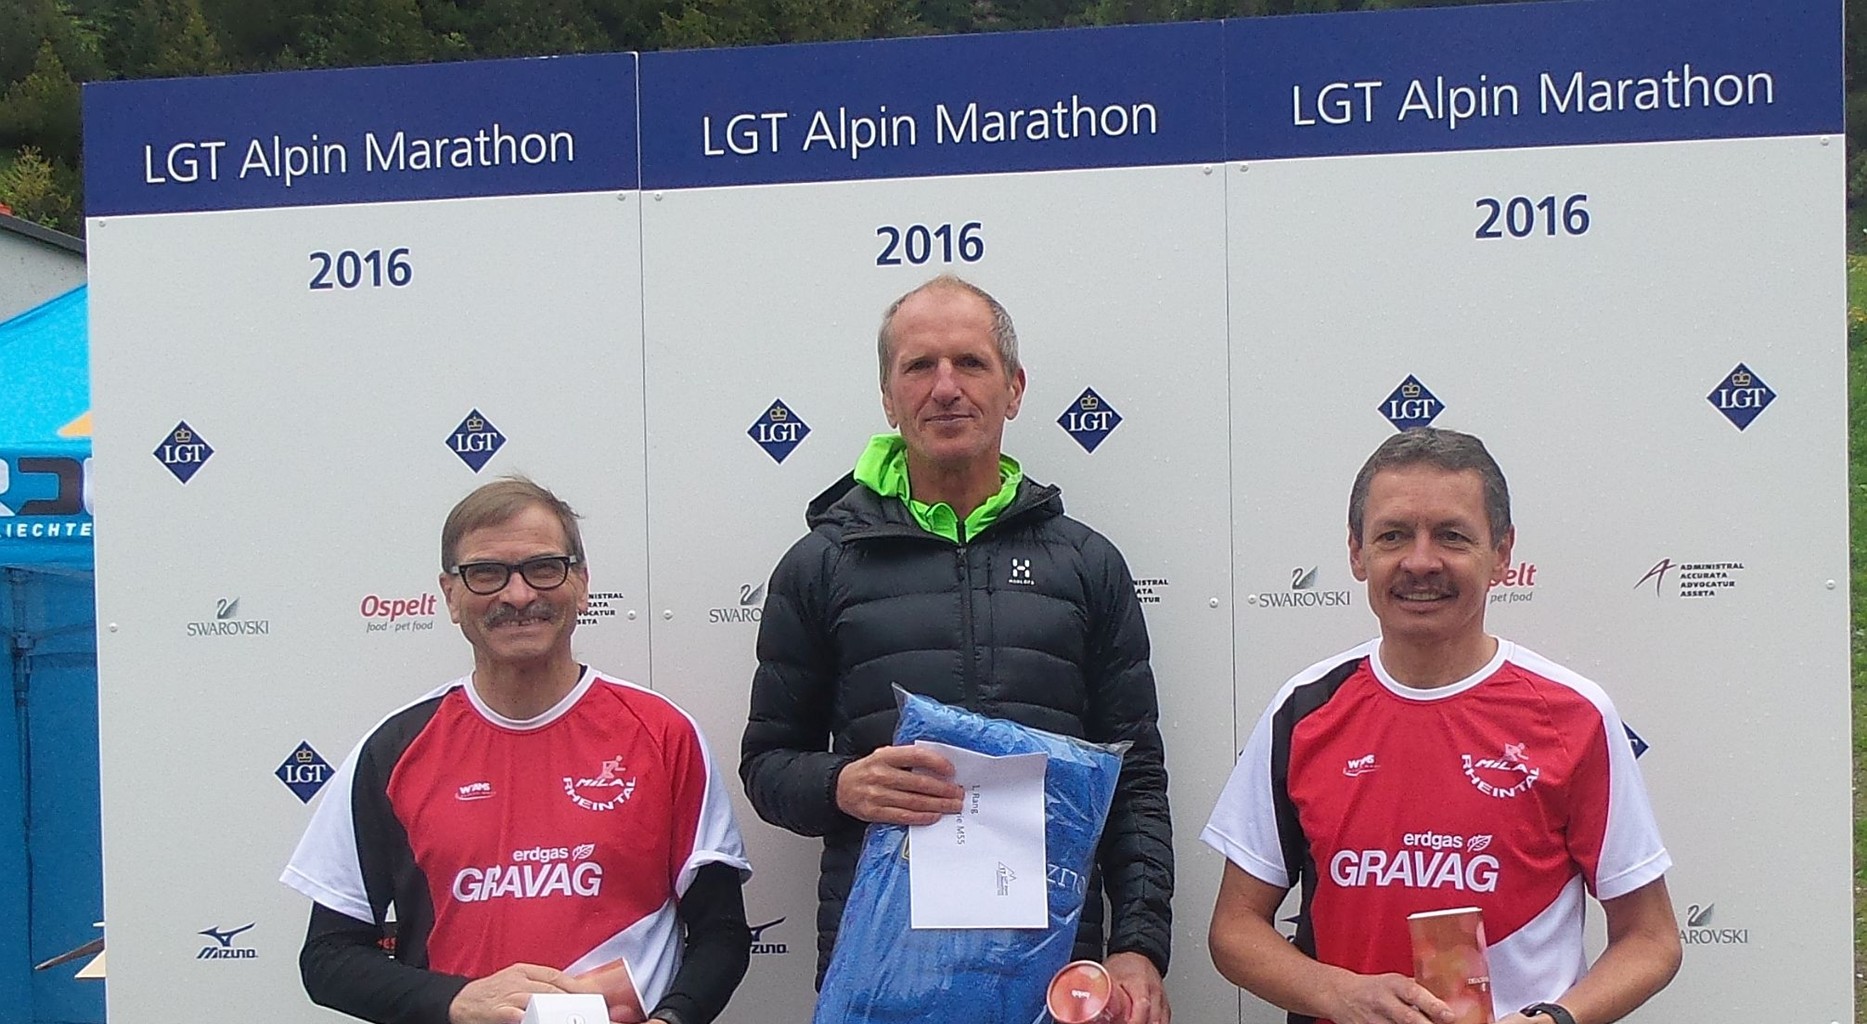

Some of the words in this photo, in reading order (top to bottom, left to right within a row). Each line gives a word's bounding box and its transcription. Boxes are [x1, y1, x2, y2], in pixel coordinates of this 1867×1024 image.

[1292, 81, 1383, 126] LGT
[1398, 75, 1519, 130] Alpin
[1539, 64, 1774, 114] Marathon
[703, 113, 788, 156] LGT
[802, 105, 917, 160] Alpin
[935, 95, 1157, 144] Marathon
[144, 141, 226, 184] LGT
[239, 135, 347, 187] Alpin
[365, 124, 575, 172] Marathon
[1475, 193, 1590, 239] 2016
[876, 221, 985, 266] 2016
[309, 248, 413, 289] 2016
[1389, 398, 1435, 419] LGT
[1718, 388, 1765, 409] LGT
[1067, 410, 1113, 432] LGT
[454, 430, 498, 452] LGT
[757, 421, 802, 443] LGT
[164, 443, 205, 463] LGT
[0, 523, 92, 536] IECHTE
[361, 593, 437, 622] Ospelt
[1259, 591, 1351, 608] SWAROVSKI
[1490, 593, 1507, 605] pet
[1509, 591, 1533, 604] food
[709, 608, 763, 623] SWARO
[187, 620, 269, 637] SWAROVSKI
[366, 622, 388, 633] food
[395, 622, 411, 632] pet
[412, 621, 433, 631] food
[285, 763, 326, 785] LGT
[1403, 830, 1463, 850] erdgas
[512, 846, 569, 863] erdgas
[1329, 850, 1499, 893] GRAVAG
[1680, 929, 1748, 944] AROVSKI
